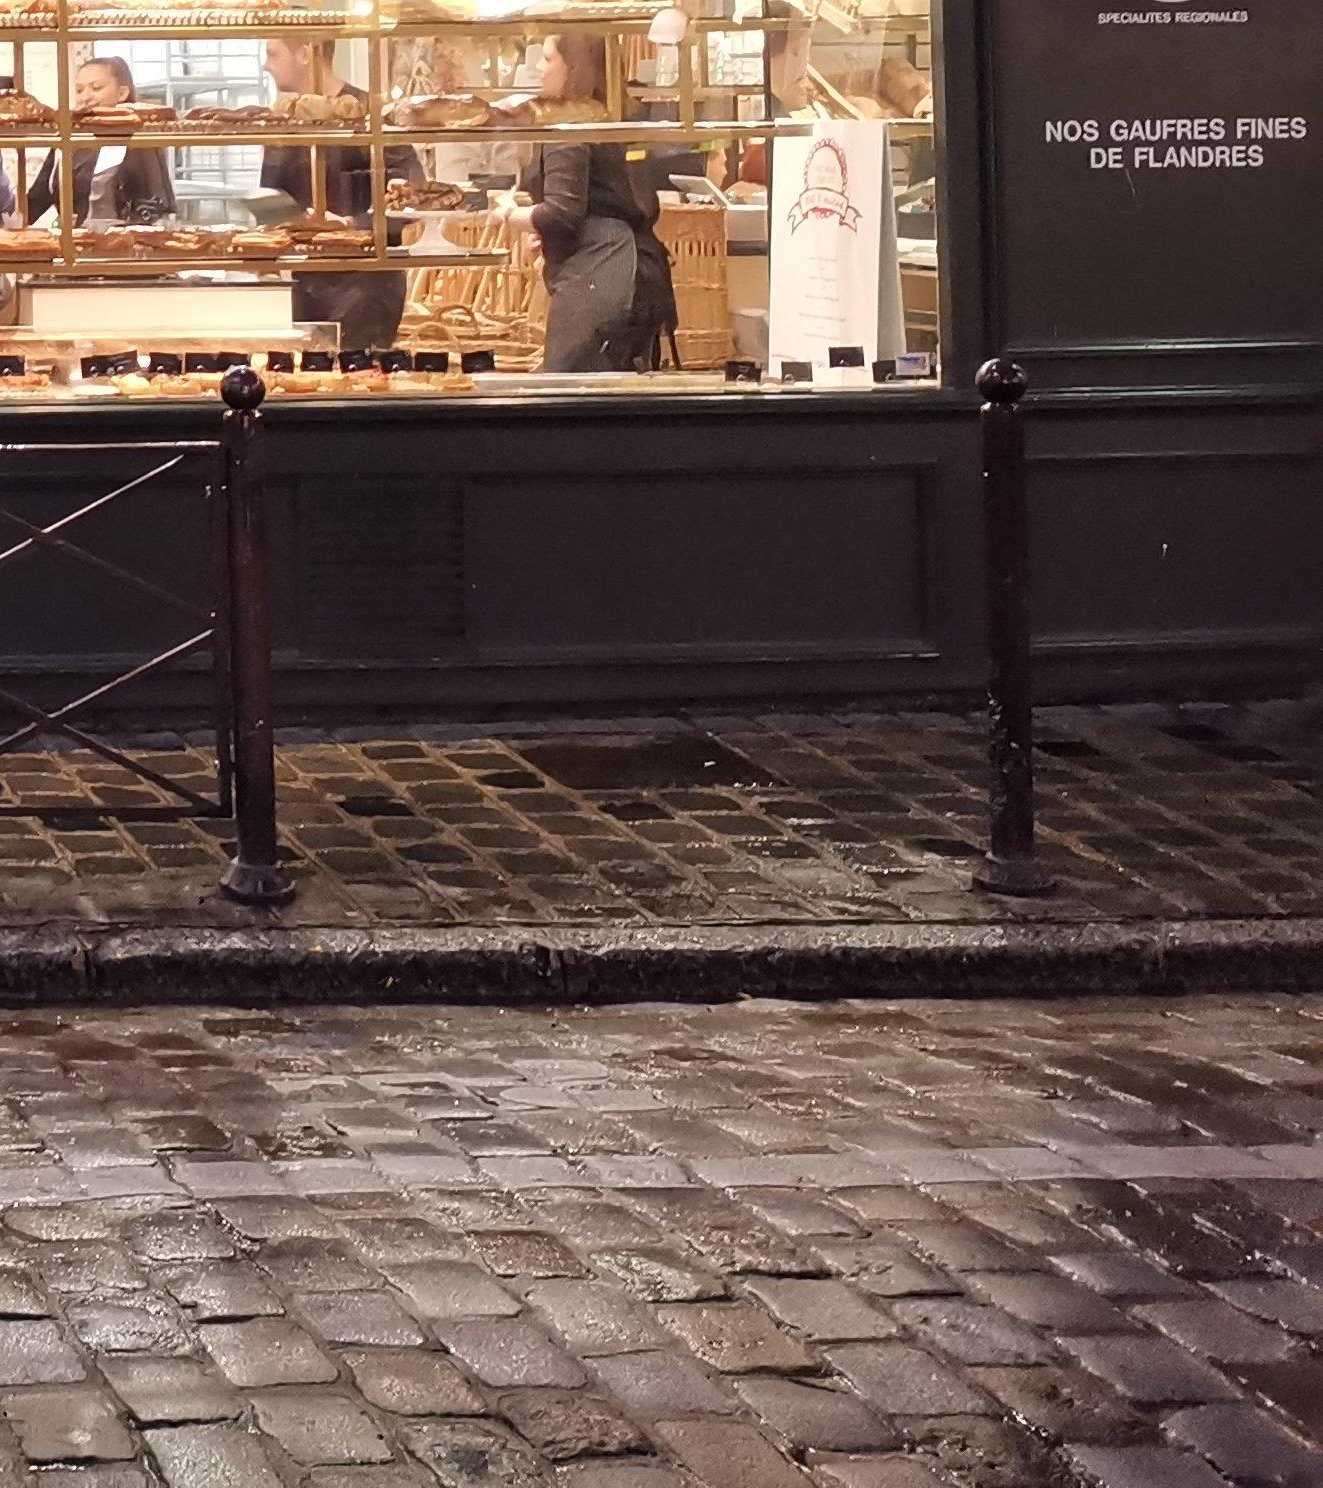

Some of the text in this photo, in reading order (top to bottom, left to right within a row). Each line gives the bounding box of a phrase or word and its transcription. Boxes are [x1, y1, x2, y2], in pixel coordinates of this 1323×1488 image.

[1098, 11, 1248, 24] SPECIALITES REGIONALES
[1045, 117, 1306, 143] NOS GAUFRES FINES
[1090, 146, 1264, 169] DE FLANDRES
